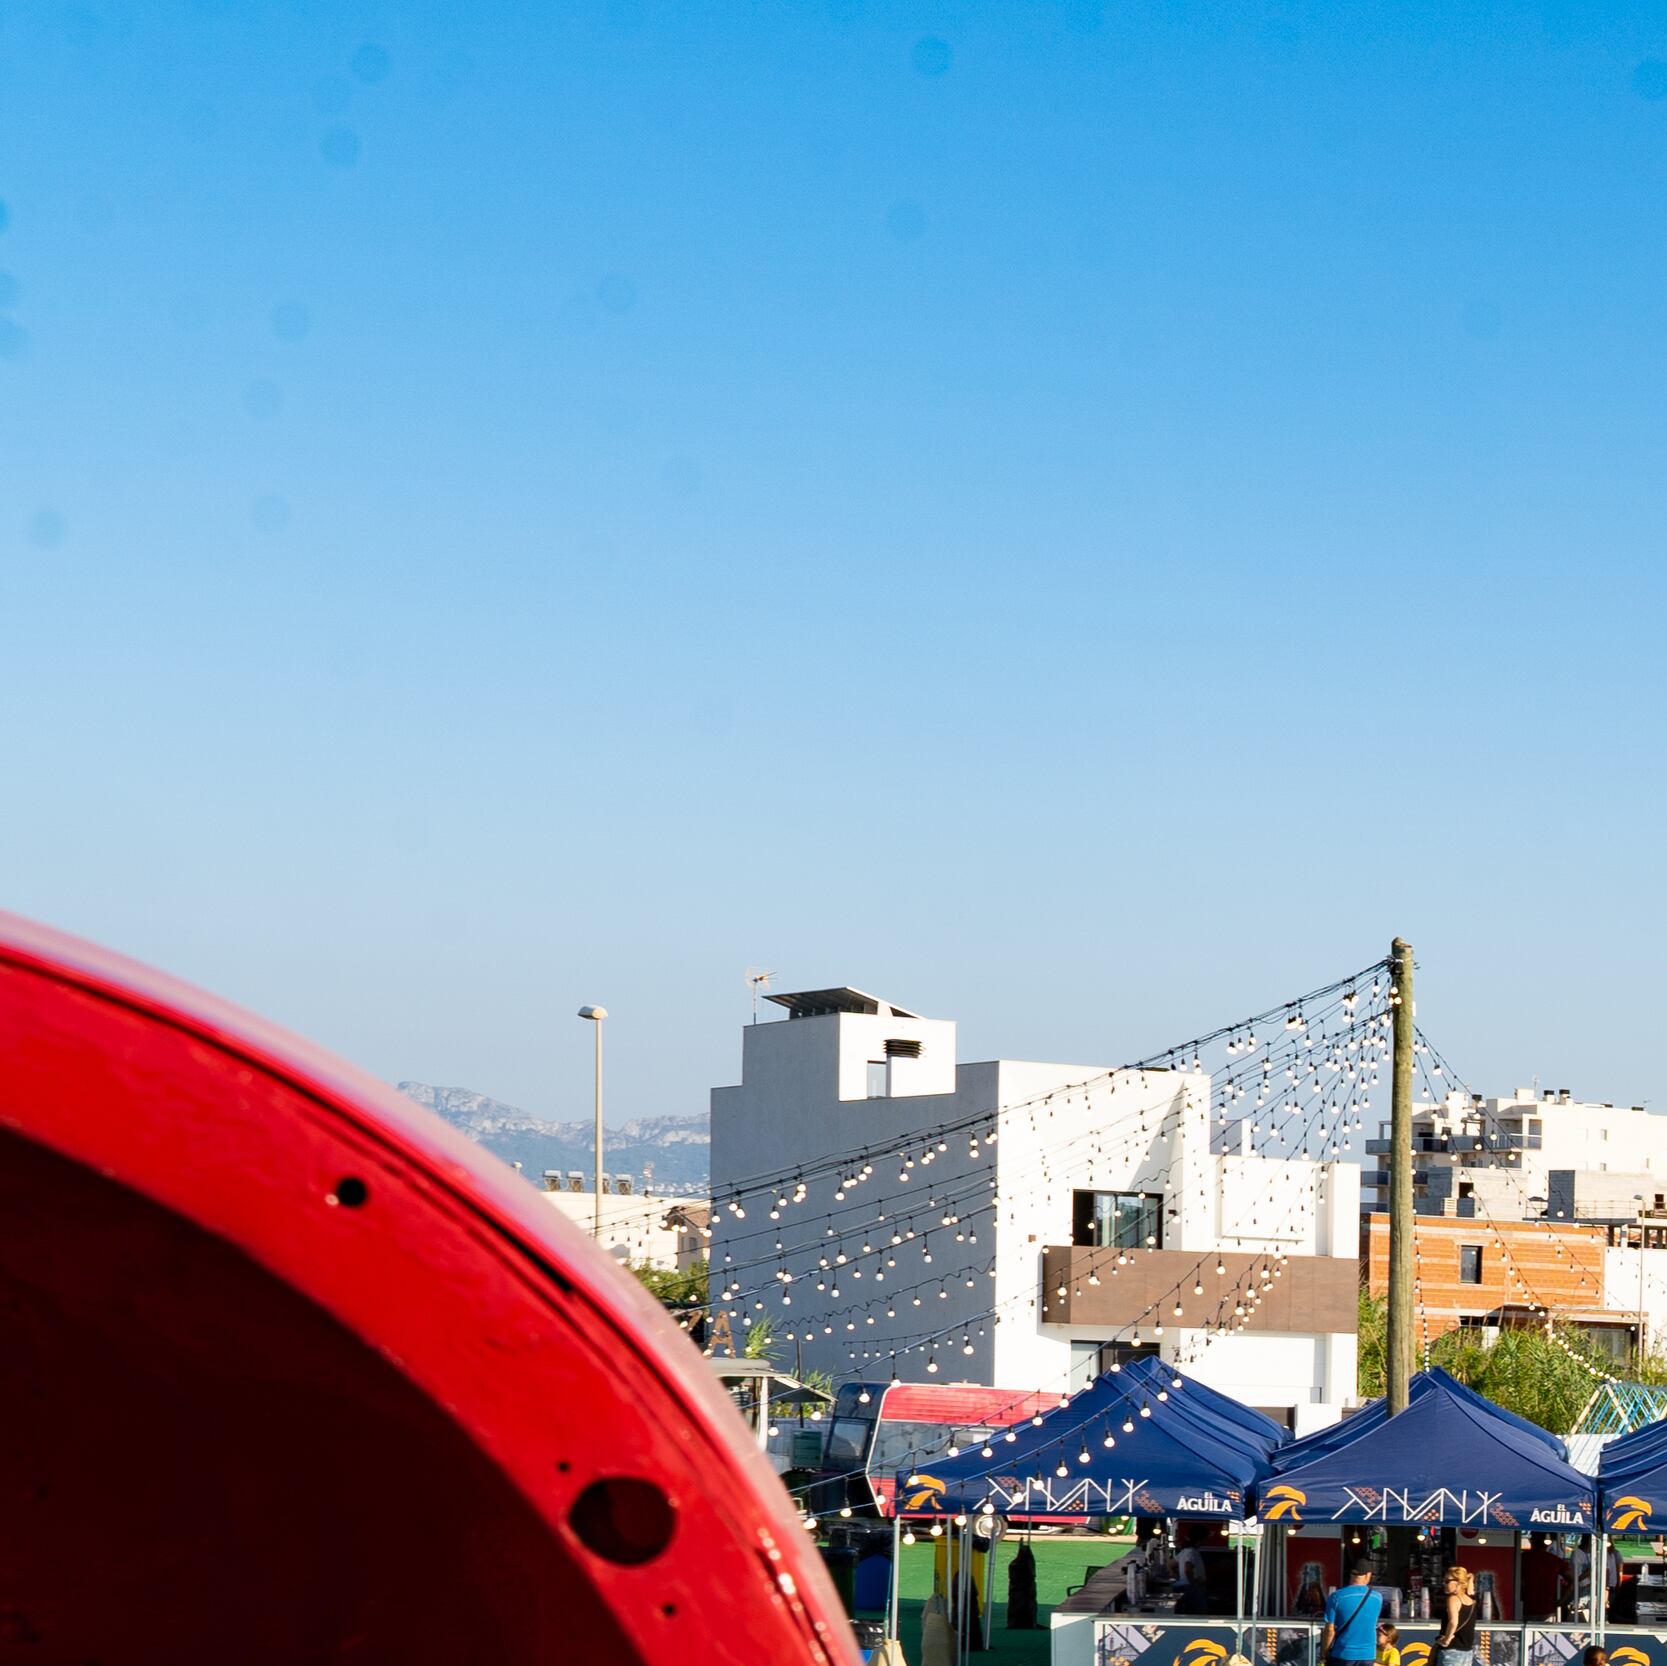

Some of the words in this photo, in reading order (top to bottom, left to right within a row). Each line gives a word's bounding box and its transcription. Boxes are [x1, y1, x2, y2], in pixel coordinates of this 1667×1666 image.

[1204, 1491, 1213, 1499] EL
[1177, 1495, 1232, 1513] ÁGUILA
[1530, 1508, 1584, 1525] ÁGUILA
